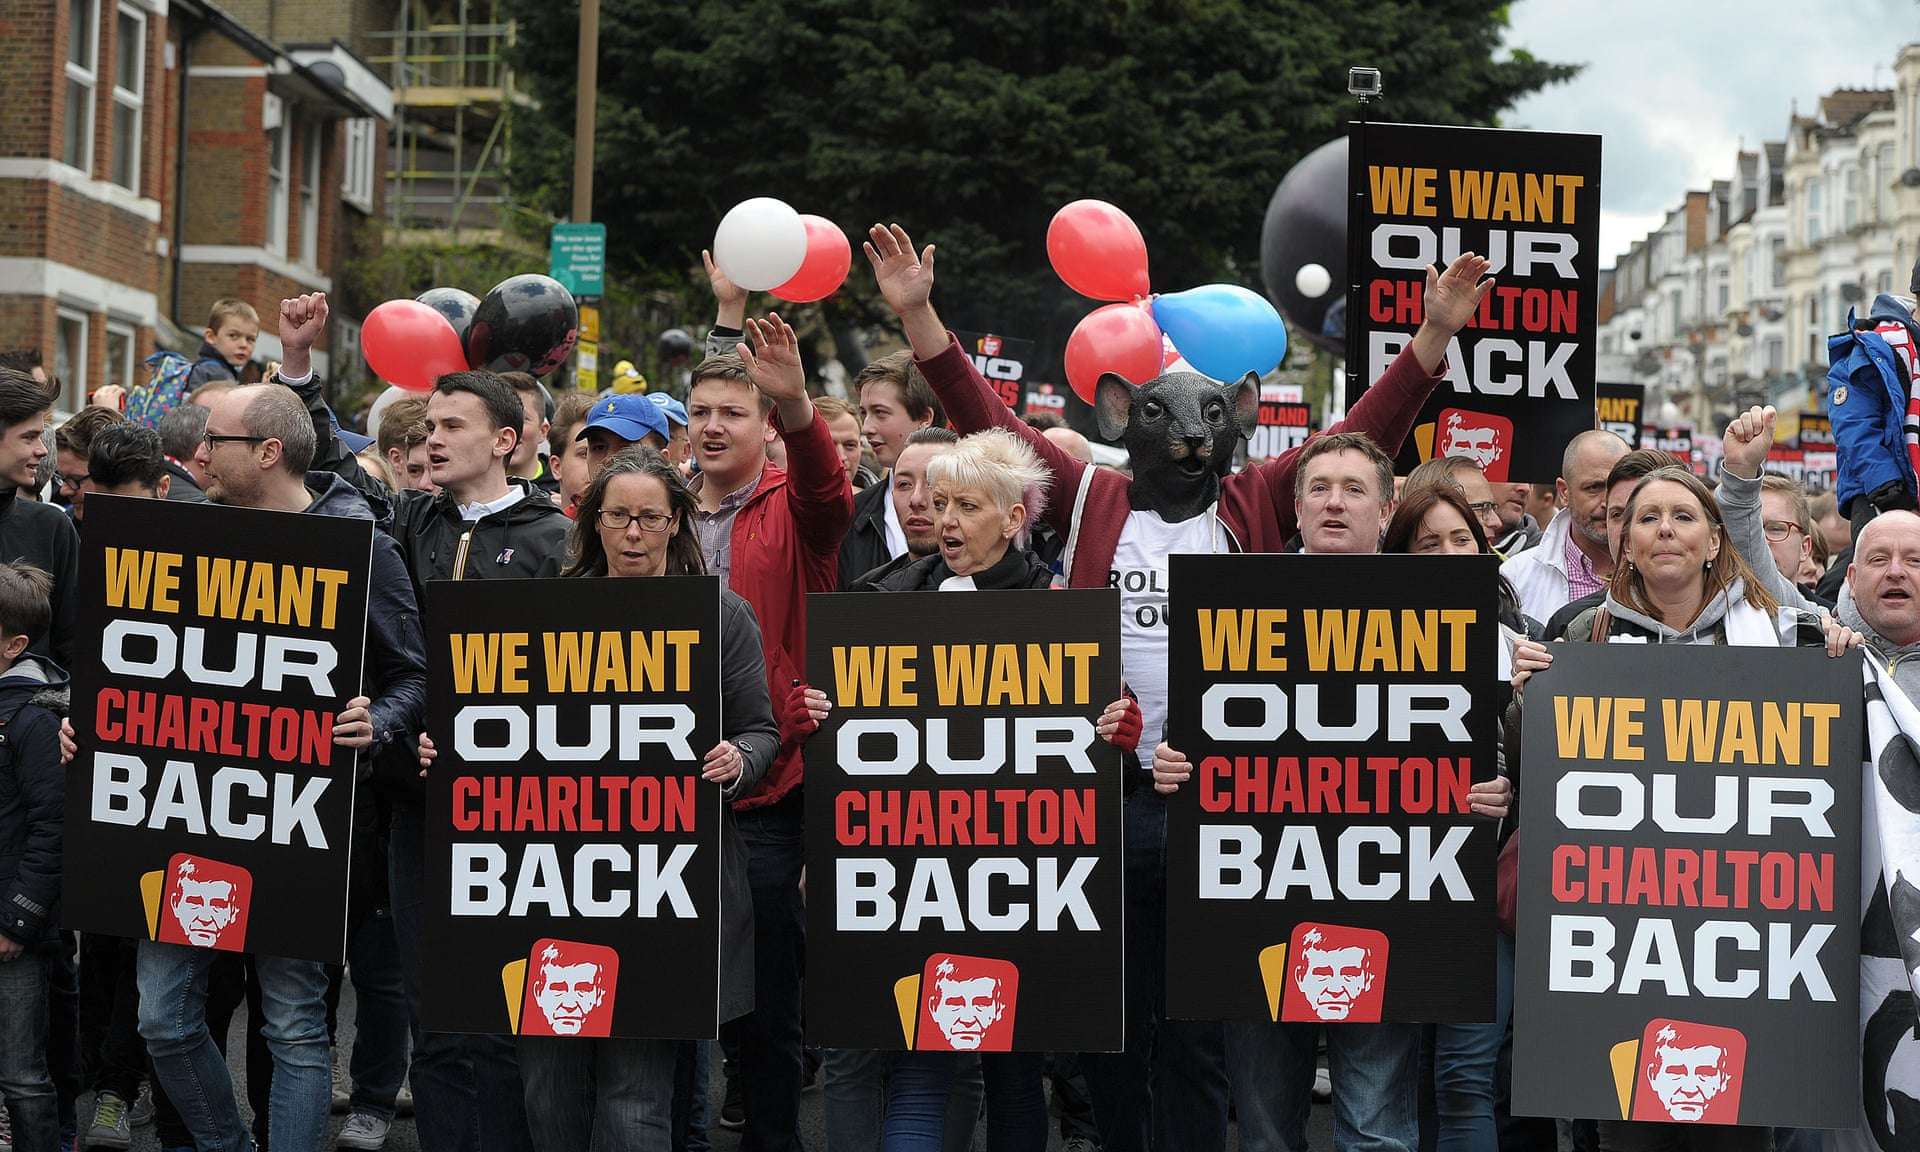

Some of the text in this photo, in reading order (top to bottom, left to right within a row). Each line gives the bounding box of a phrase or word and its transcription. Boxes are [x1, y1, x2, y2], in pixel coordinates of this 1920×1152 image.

[1369, 166, 1583, 224] WE WANT
[1372, 224, 1578, 279] OUR
[1370, 280, 1578, 333] CHLTON
[1258, 405, 1308, 427] OLAND
[1597, 398, 1639, 422] ANT
[106, 547, 348, 629] WE WANT
[1106, 570, 1169, 593] ROL
[102, 619, 337, 697] OUR
[450, 630, 699, 693] WE WANT
[1198, 609, 1476, 671] WE WANT
[833, 643, 1099, 707] WE WANT
[96, 688, 333, 765] CHARLTON
[455, 704, 696, 761] OUR
[1202, 684, 1472, 741] OUR
[1554, 696, 1841, 766] WE WANT
[837, 717, 1096, 775] OUR
[92, 752, 332, 849] BACK
[453, 776, 695, 831] CHARLTON
[1200, 757, 1471, 813] CHARLTON
[1556, 771, 1835, 837] OUR
[836, 789, 1095, 845] CHARLTON
[451, 843, 698, 918] BACK
[1199, 825, 1474, 900] BACK
[1552, 845, 1834, 911] CHARLTON
[836, 857, 1100, 931] BACK
[1549, 915, 1836, 1001] BACK
